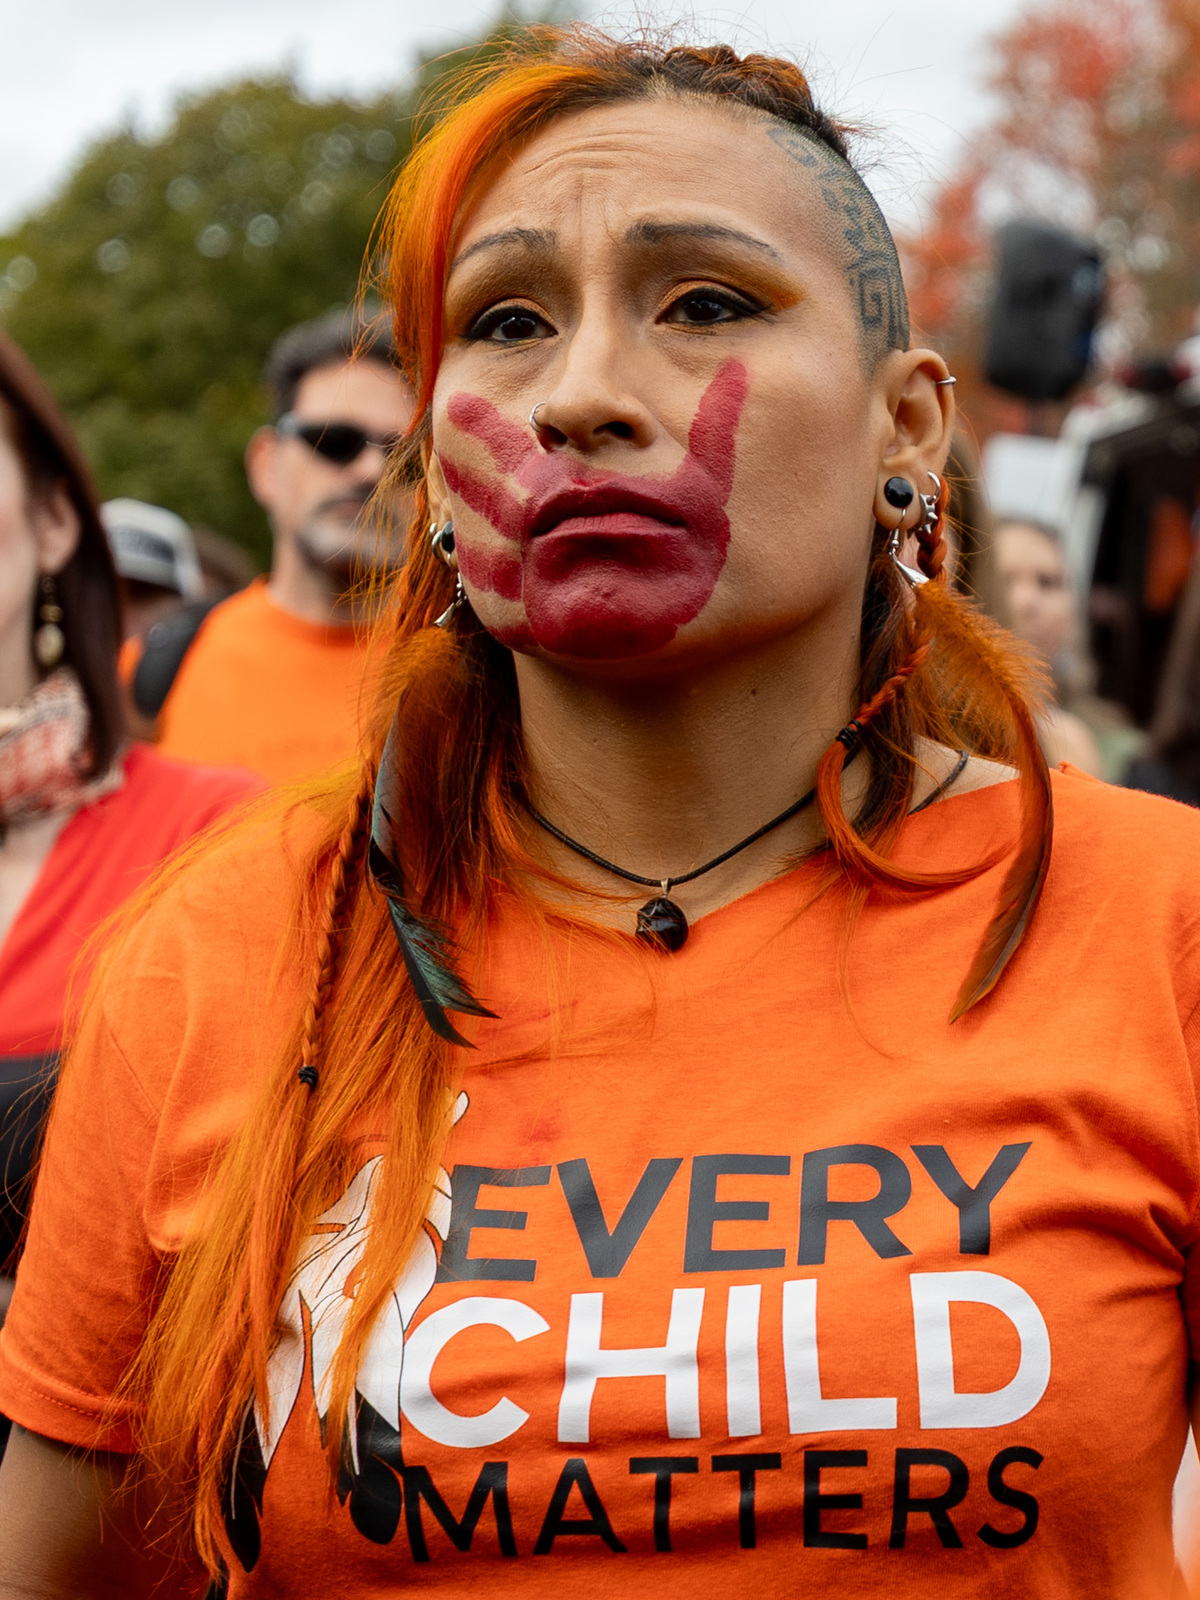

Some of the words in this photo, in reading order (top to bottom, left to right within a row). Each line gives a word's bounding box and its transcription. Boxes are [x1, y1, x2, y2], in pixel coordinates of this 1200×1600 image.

[437, 1142, 1032, 1282] EVERY
[400, 1271, 1051, 1448] CHILD
[402, 1446, 1044, 1562] MATTERS
